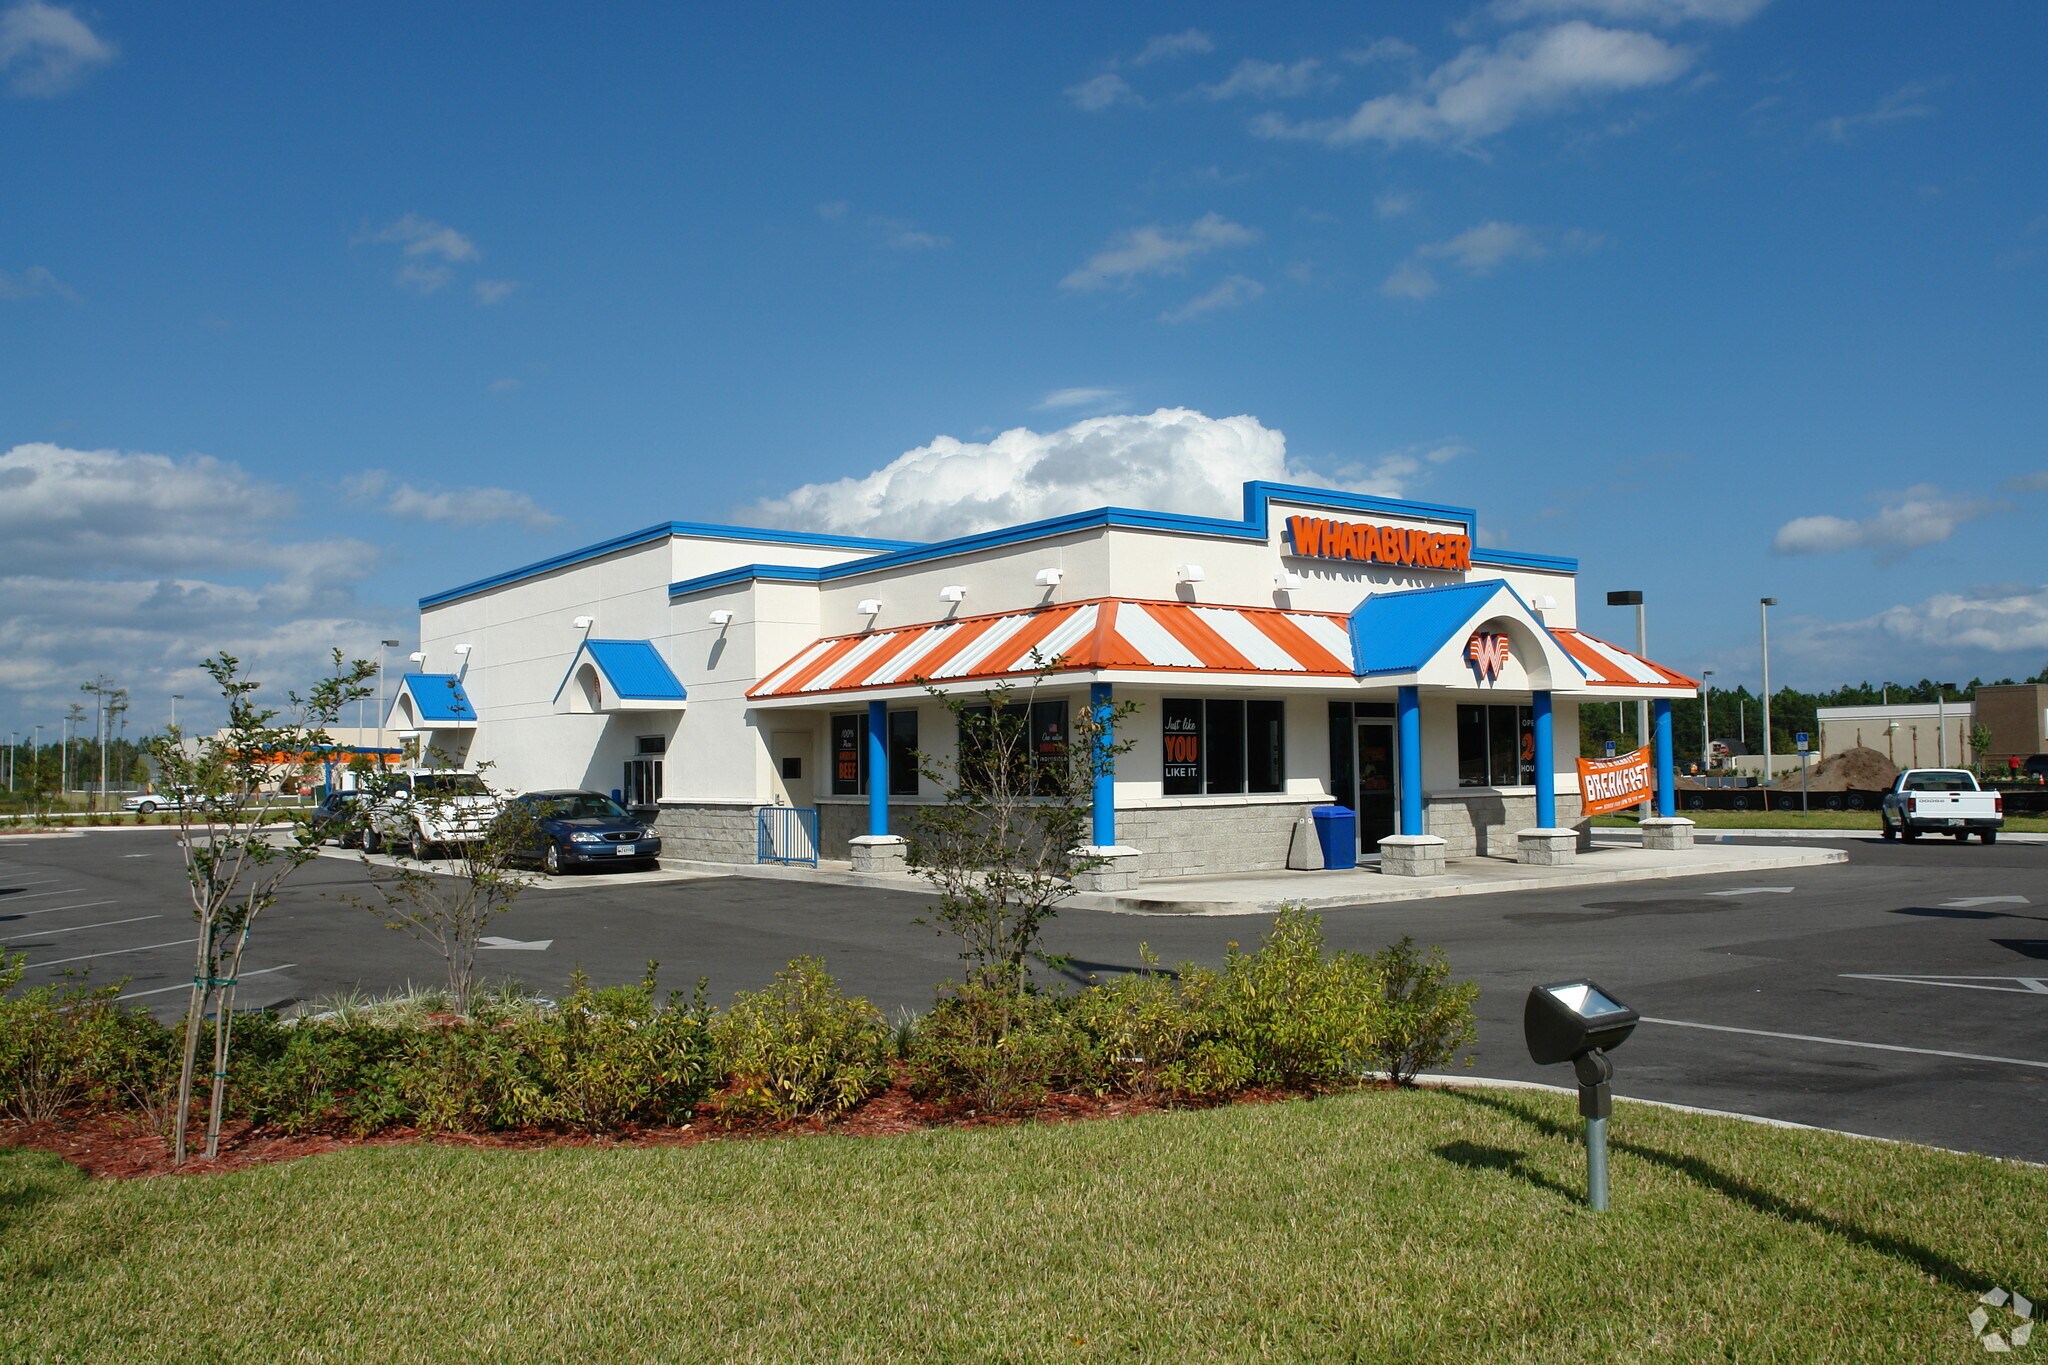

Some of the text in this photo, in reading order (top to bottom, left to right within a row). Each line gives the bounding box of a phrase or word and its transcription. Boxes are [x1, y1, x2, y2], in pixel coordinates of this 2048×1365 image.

[1286, 515, 1472, 570] WHATABURGER
[1470, 632, 1509, 681] W
[1165, 717, 1196, 730] Just like
[1164, 735, 1198, 762] YOU
[1521, 732, 1535, 760] 2
[839, 762, 856, 779] BEEF
[1166, 768, 1198, 777] LIKE IT.
[1585, 762, 1649, 801] BREAKFAST
